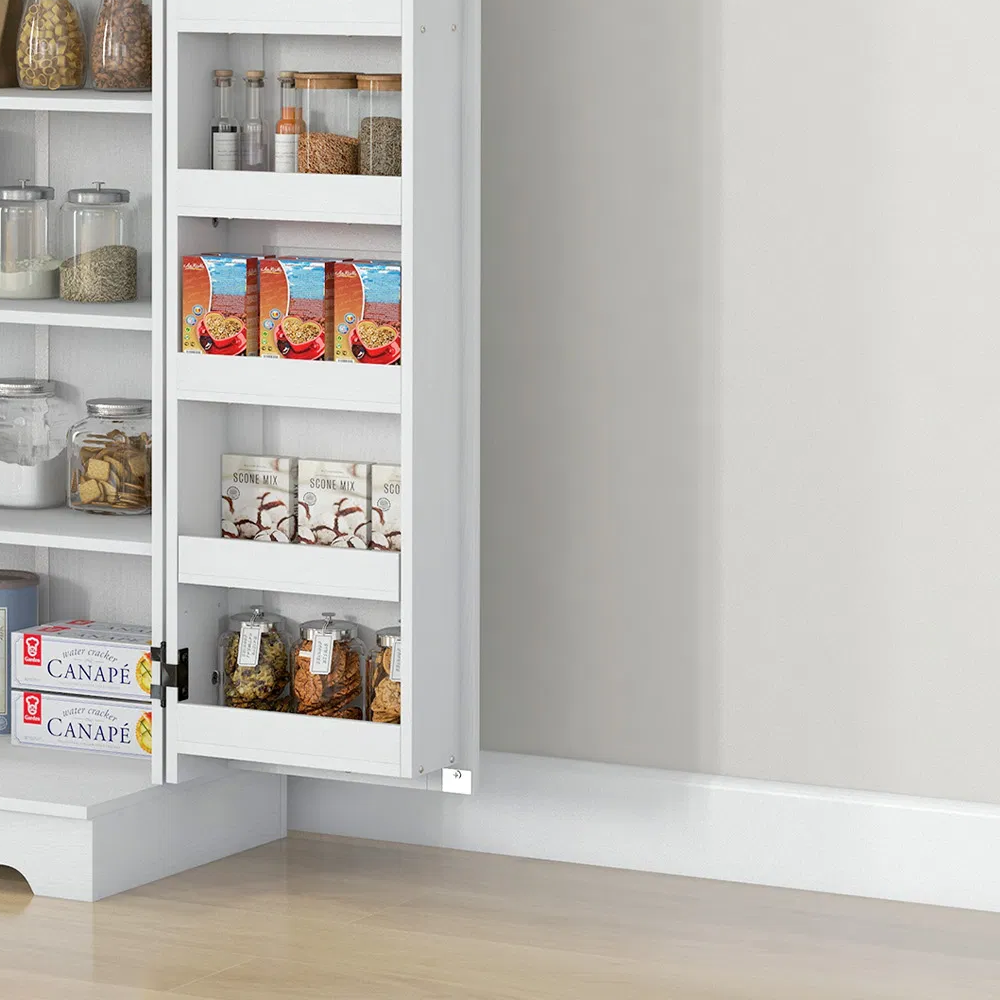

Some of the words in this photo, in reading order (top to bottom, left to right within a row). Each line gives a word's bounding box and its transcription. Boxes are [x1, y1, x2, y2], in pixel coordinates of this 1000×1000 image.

[232, 472, 260, 485] SCONE
[262, 474, 278, 486] MIX
[309, 477, 337, 490] SCONE
[340, 480, 355, 492] MIX
[383, 483, 401, 495] SCO
[62, 648, 86, 659] water
[87, 648, 118, 663] cracker
[46, 658, 131, 685] CANAPÉ
[62, 707, 86, 718] water
[87, 707, 118, 722] cracker
[46, 717, 131, 744] CANAPÉ
